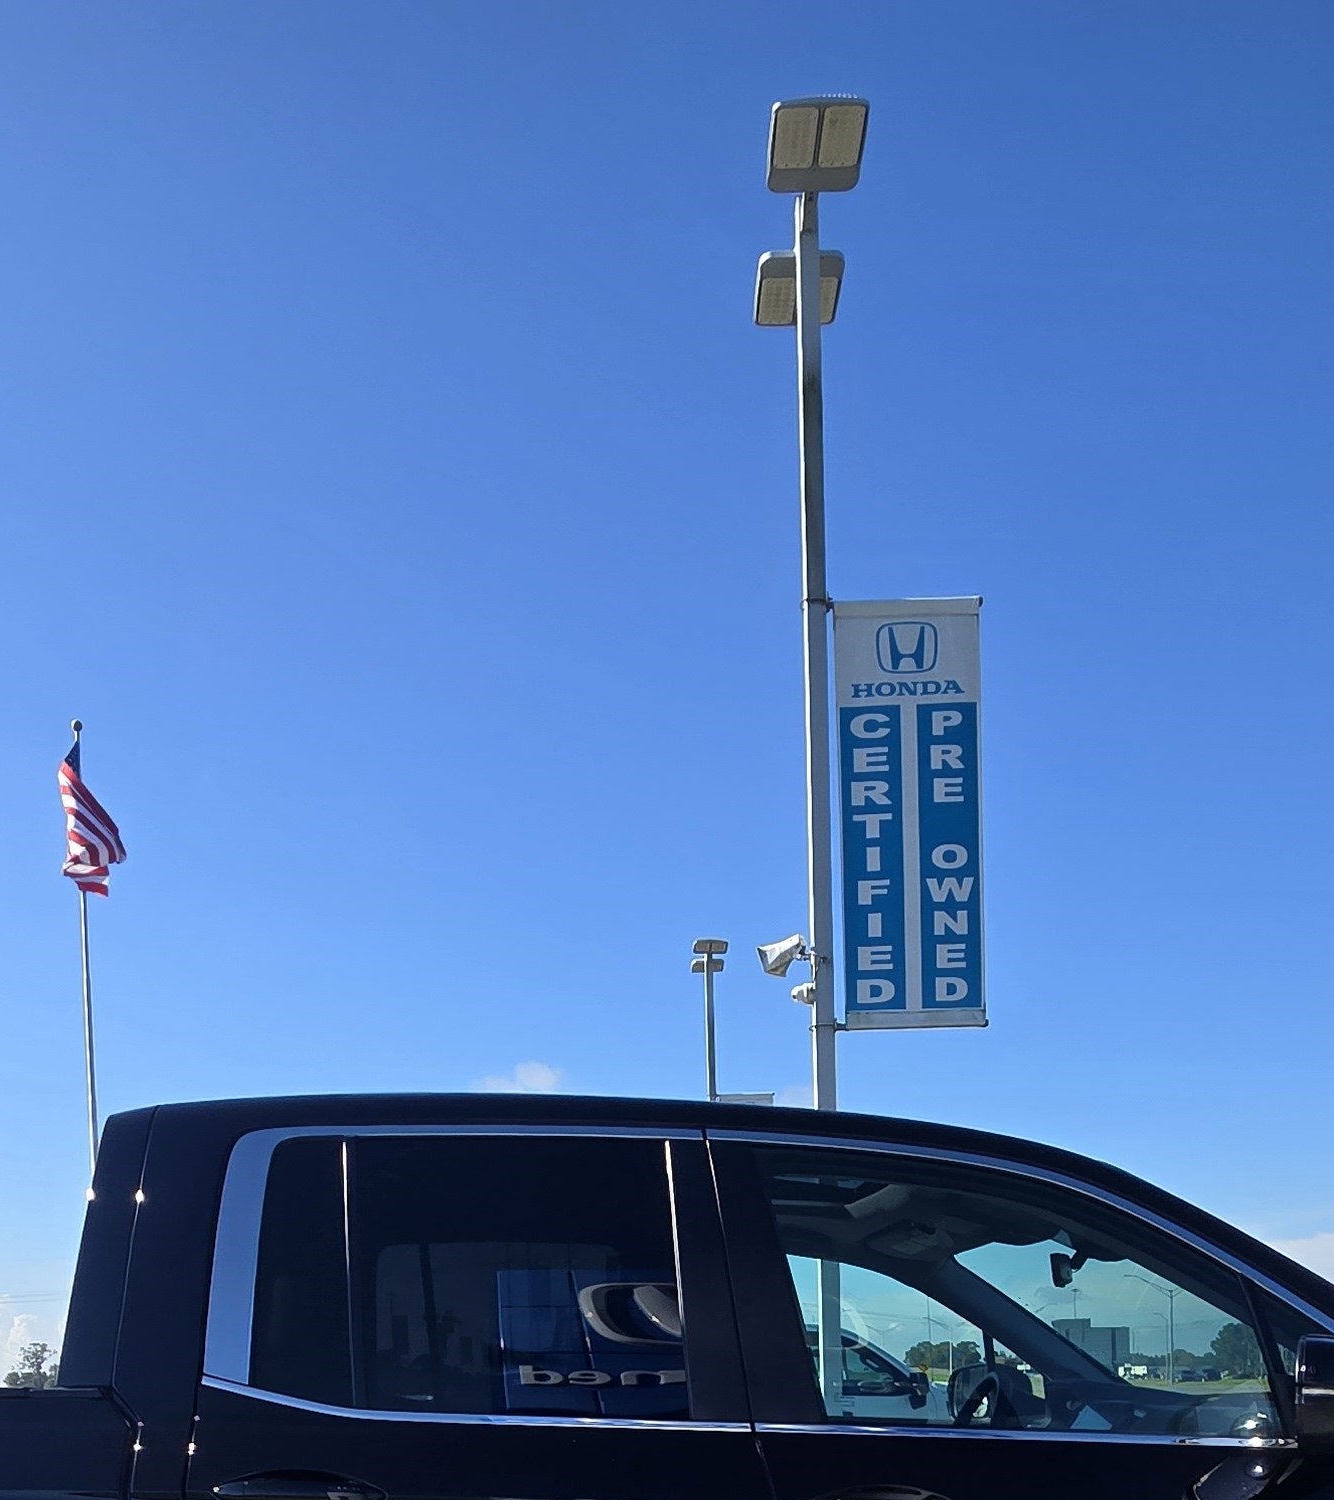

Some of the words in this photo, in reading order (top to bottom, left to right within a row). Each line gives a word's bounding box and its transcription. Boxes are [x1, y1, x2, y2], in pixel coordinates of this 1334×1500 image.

[851, 680, 965, 698] HONDA
[930, 710, 965, 803] PRE
[850, 713, 896, 1004] CERTIFIED
[926, 843, 974, 1002] OWNED
